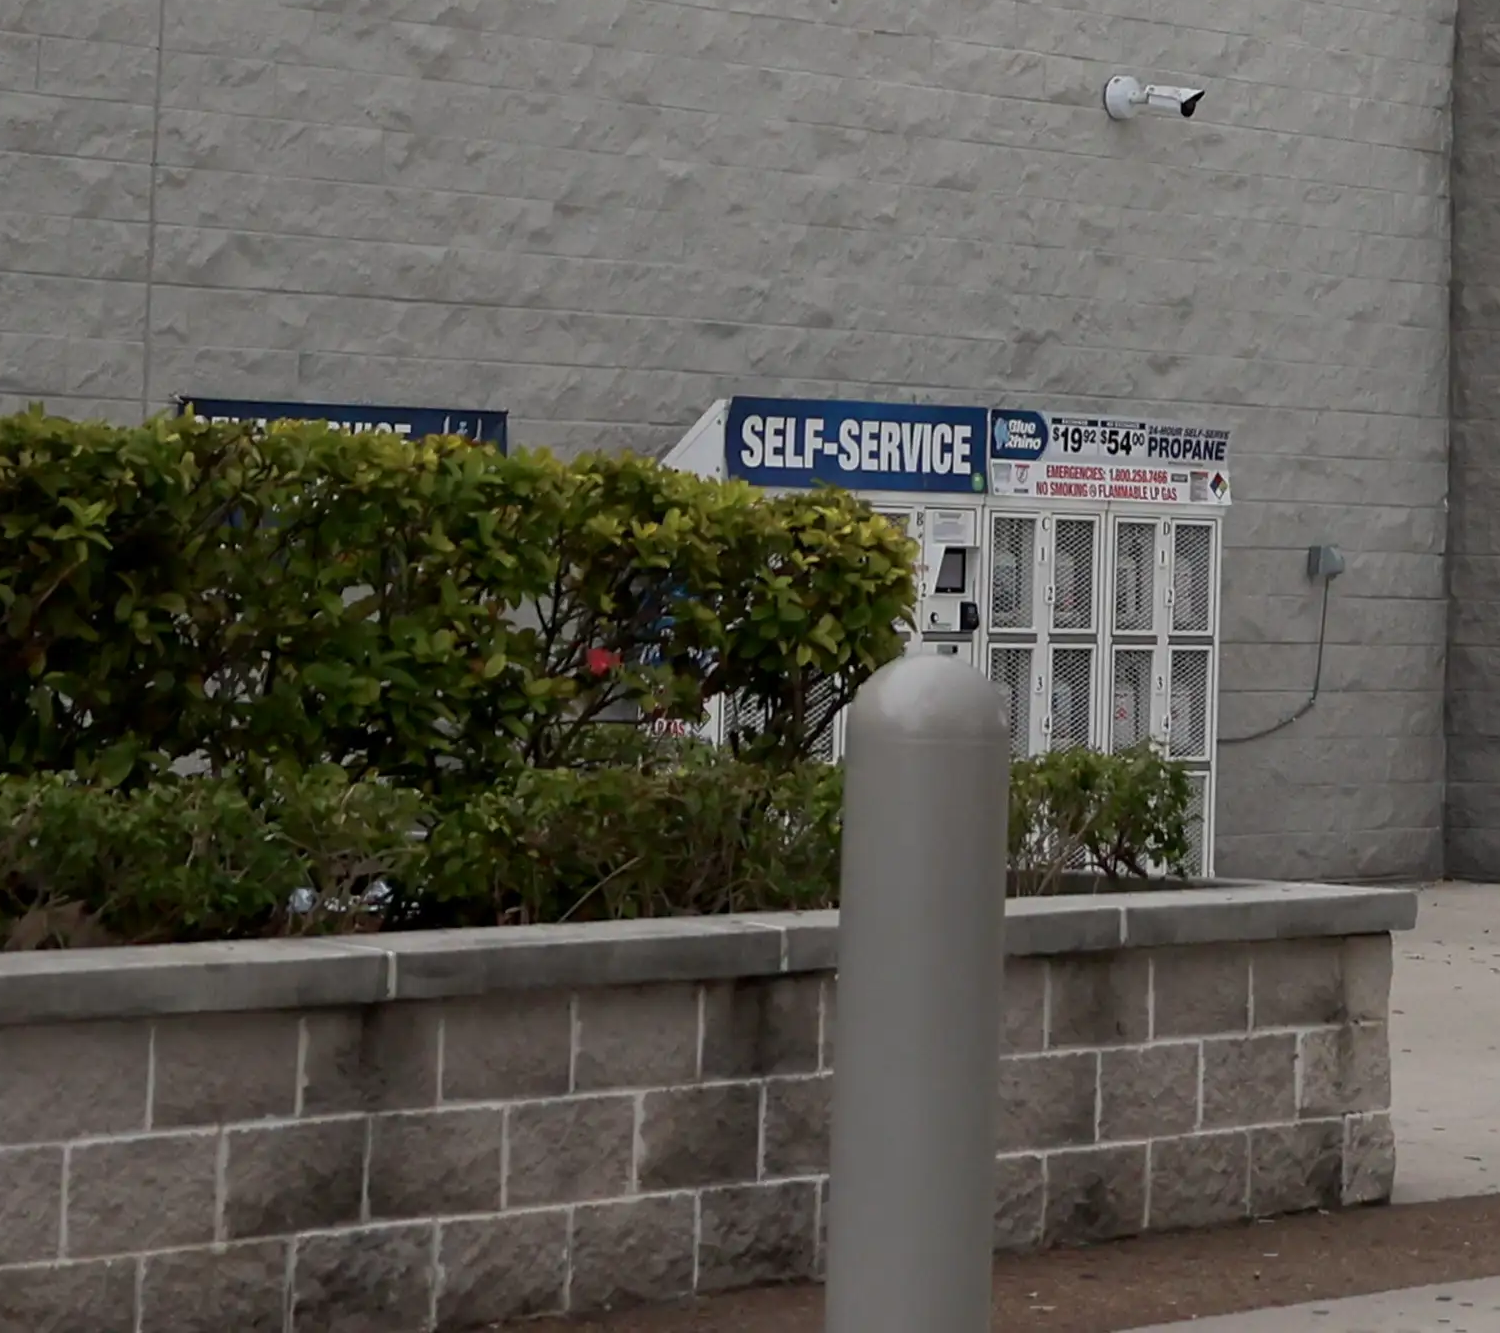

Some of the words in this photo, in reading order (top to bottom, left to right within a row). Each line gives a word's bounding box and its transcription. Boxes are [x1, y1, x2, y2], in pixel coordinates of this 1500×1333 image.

[1008, 419, 1036, 434] Blue
[740, 414, 972, 475] SELF-SERVICE
[1147, 436, 1226, 461] PROPANE
[1046, 464, 1105, 481] EMERGENCIES:
[1035, 481, 1049, 496] NO
[1049, 482, 1088, 498] SMOKING
[1098, 483, 1149, 500] FLAMMABLE
[1150, 486, 1160, 501] LP
[1161, 486, 1178, 502] GAS
[1041, 516, 1051, 531] C
[1163, 521, 1171, 536] D
